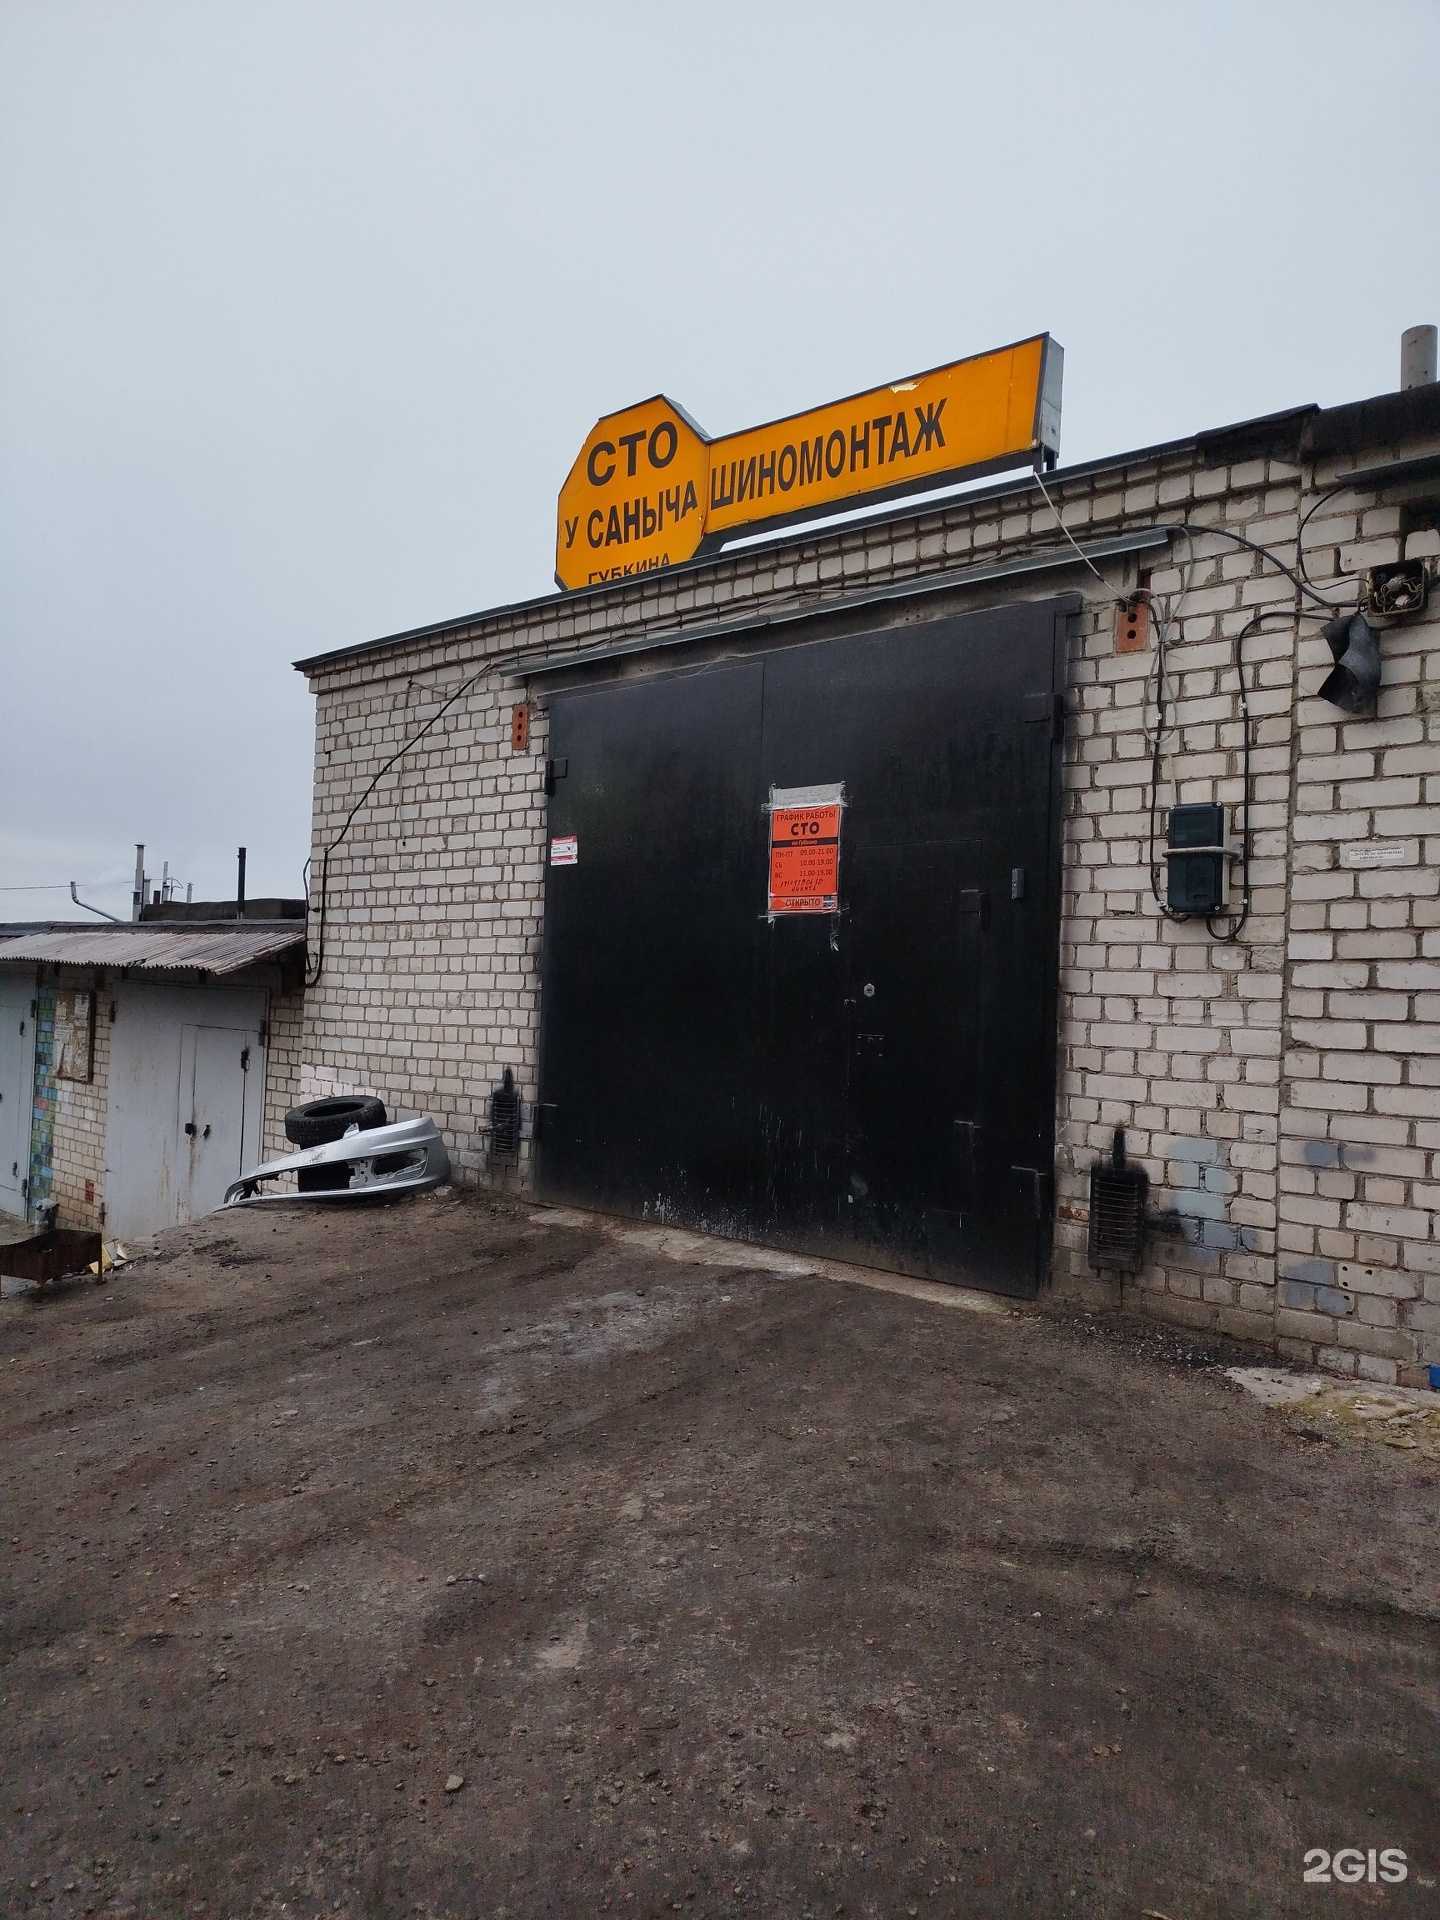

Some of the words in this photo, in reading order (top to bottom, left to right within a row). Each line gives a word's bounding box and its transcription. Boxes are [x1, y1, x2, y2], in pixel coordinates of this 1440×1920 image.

[587, 421, 678, 486] СТО
[710, 398, 948, 510] ШИНОМОНТАЖ
[565, 516, 579, 548] У
[587, 479, 698, 548] САНЫЧА
[776, 814, 805, 822] ГРАФИК
[806, 810, 836, 820] РАБОТЫ
[791, 822, 820, 836] СТО
[784, 898, 821, 907] ОТКРЫТО
